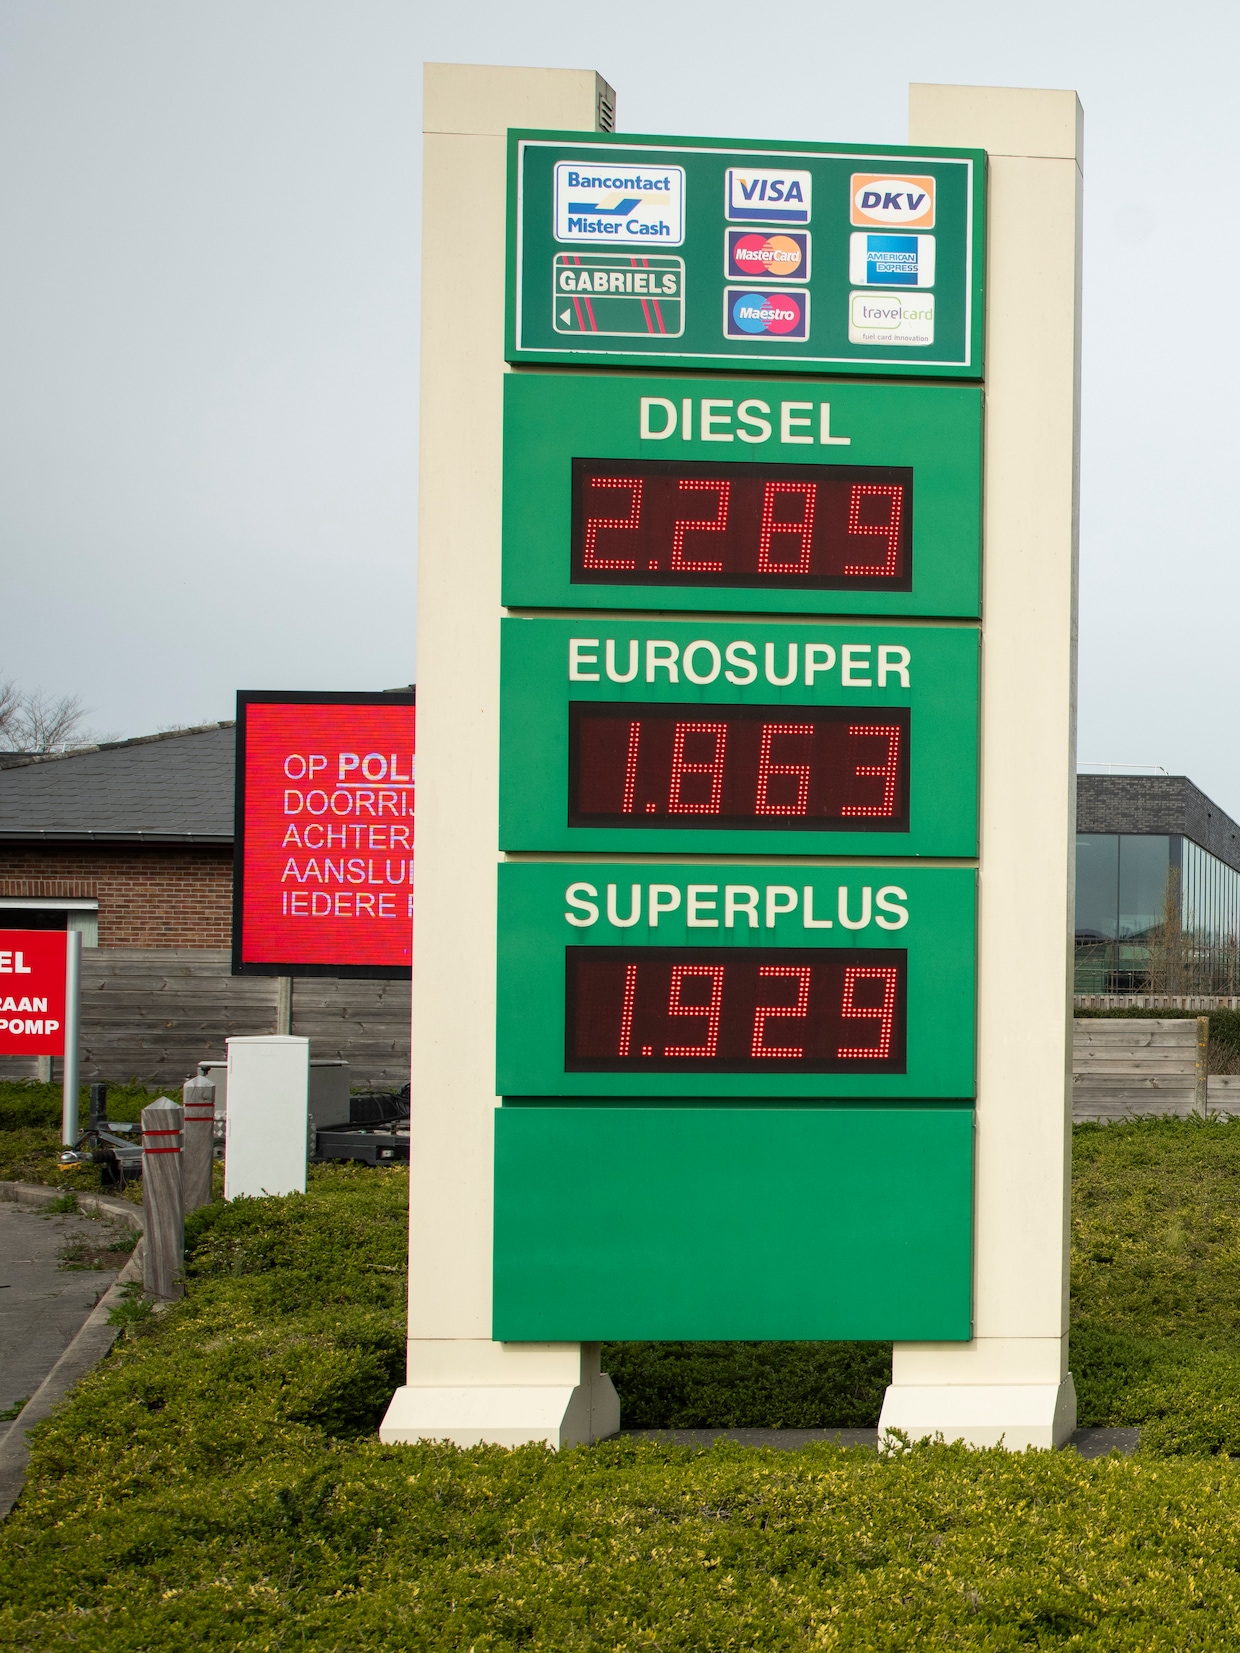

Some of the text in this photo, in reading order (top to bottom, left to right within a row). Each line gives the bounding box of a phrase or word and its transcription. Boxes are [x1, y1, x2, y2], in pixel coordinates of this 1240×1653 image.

[568, 171, 670, 191] Bancontact
[736, 179, 804, 203] VISA
[861, 191, 926, 211] DKV
[568, 217, 671, 236] Mister Cash
[735, 249, 800, 262] MasterCard
[867, 253, 915, 262] AMERICAN
[877, 264, 918, 272] EXPRESS
[560, 270, 677, 294] GABRIELS
[739, 307, 794, 321] Maestro
[863, 306, 933, 321] travelcard
[894, 334, 929, 342] innovation
[640, 396, 851, 446] DIESEL
[583, 478, 903, 576] 2.289
[568, 638, 911, 688] EUROSUPER
[283, 754, 328, 780] OP
[622, 722, 900, 817] 1.863
[281, 823, 414, 850] ACHTER
[282, 891, 397, 917] IEDERE
[564, 882, 909, 931] SUPERPLUS
[618, 965, 897, 1058] 1.929
